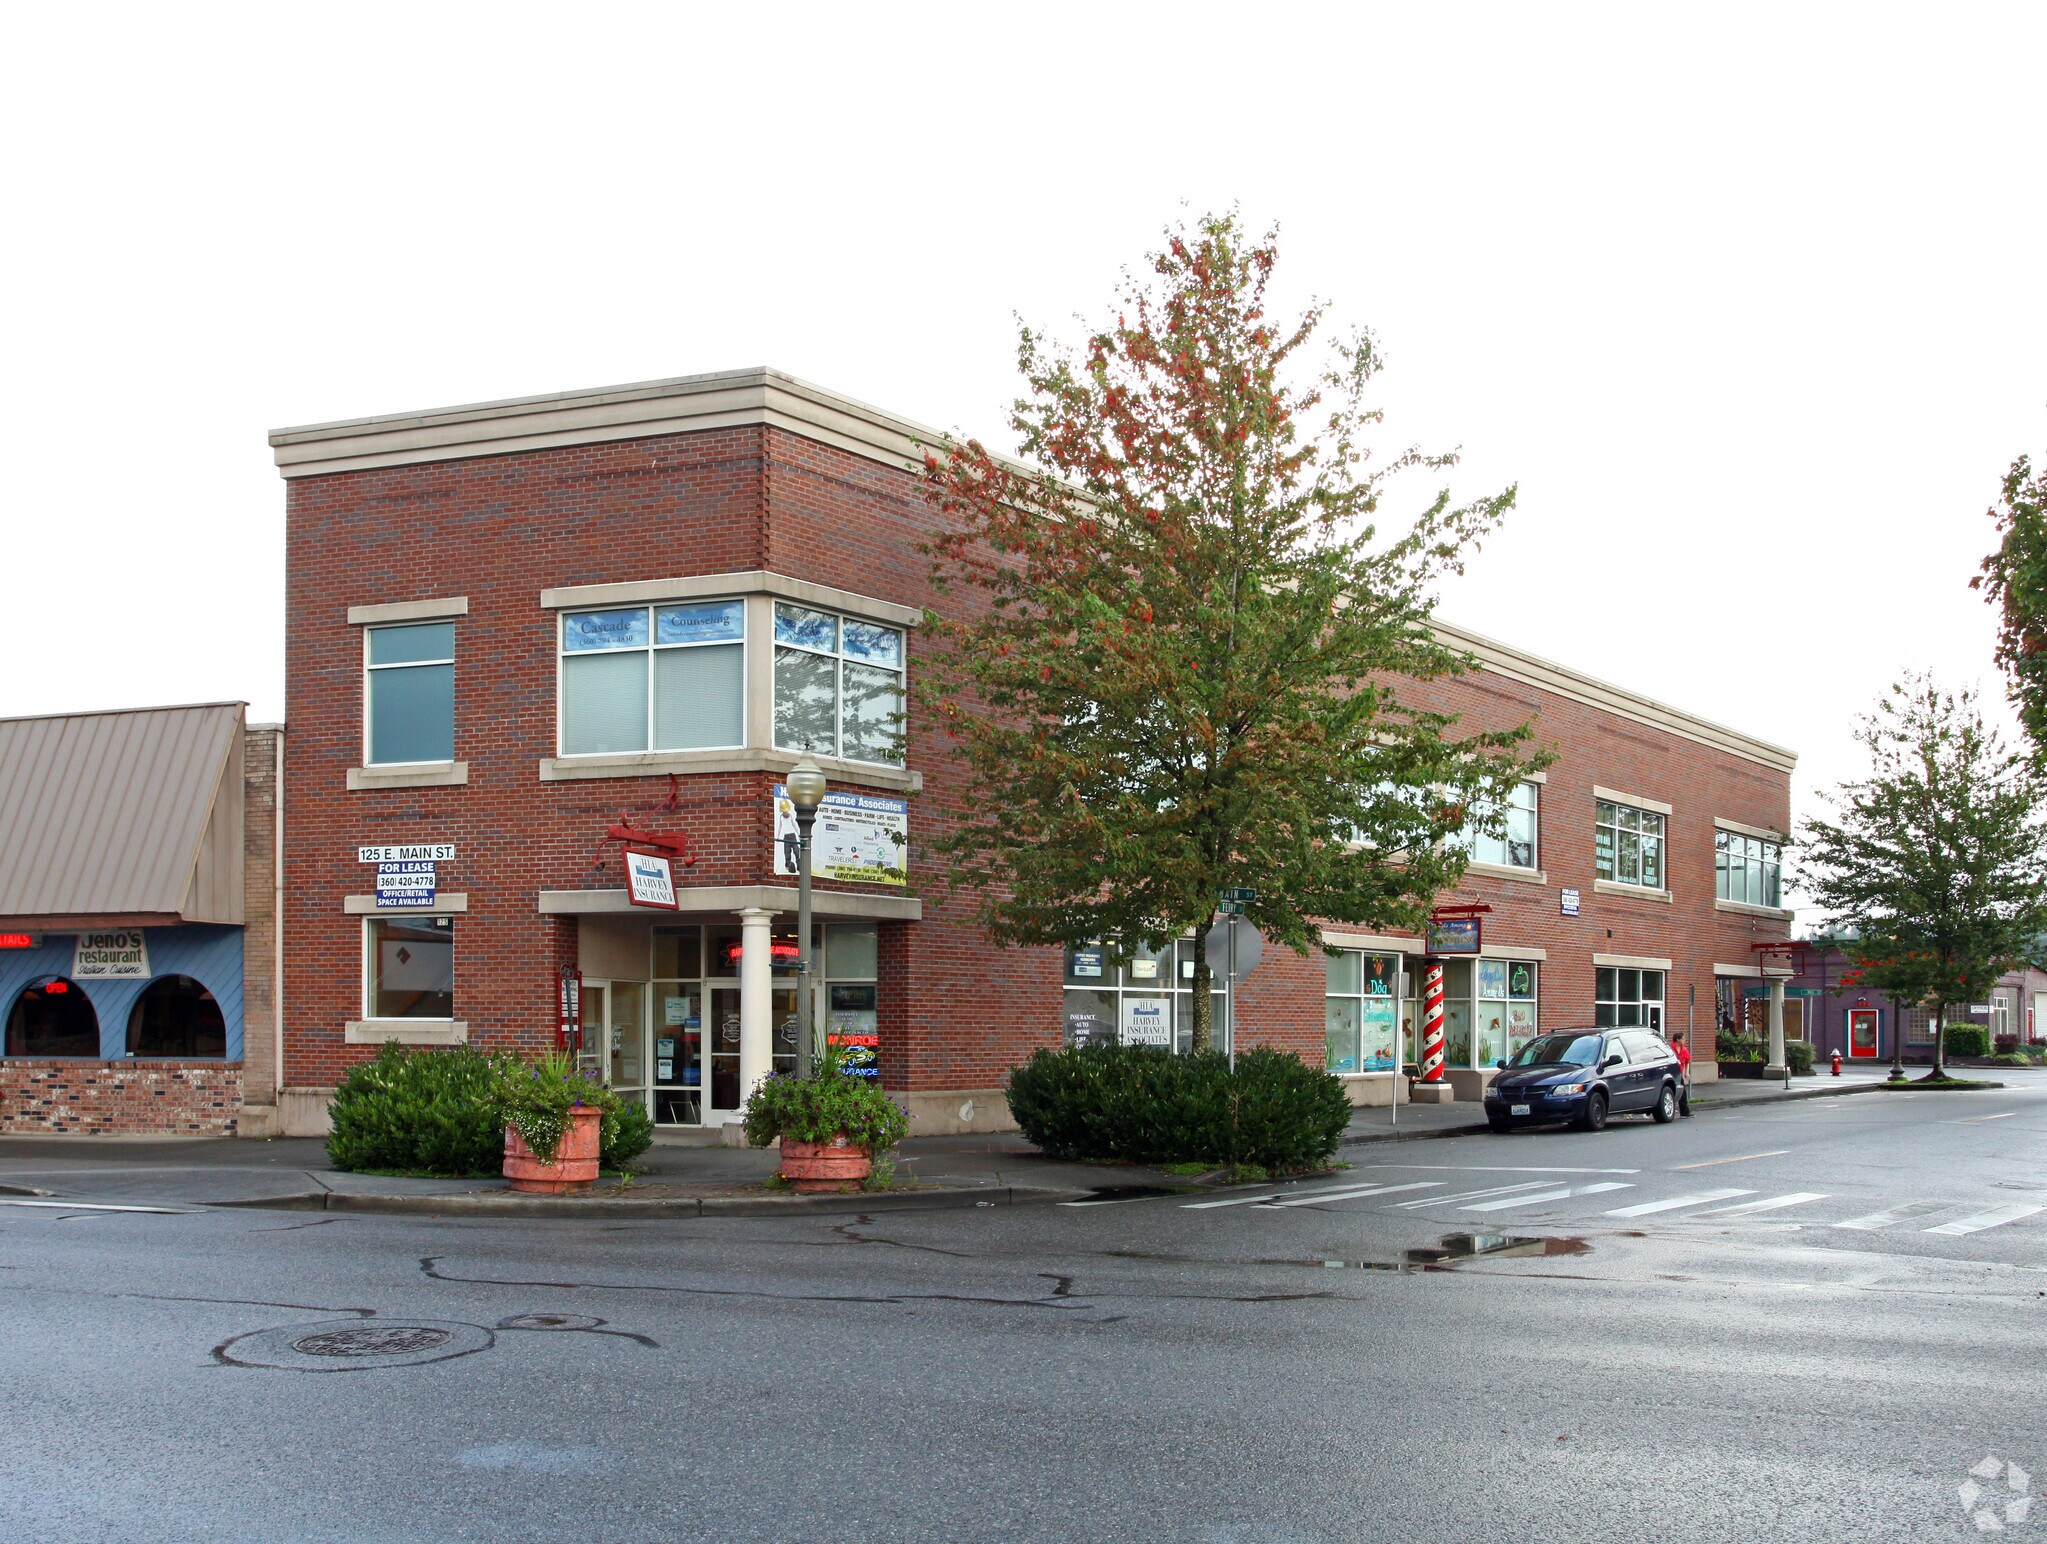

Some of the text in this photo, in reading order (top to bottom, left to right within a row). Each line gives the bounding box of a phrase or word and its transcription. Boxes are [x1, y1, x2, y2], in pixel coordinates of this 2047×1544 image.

[581, 615, 730, 634] Cascade Counseling
[822, 794, 902, 812] surance Associates
[844, 810, 862, 818] BUSINESS
[361, 847, 453, 860] 125 E. MAIN ST.
[828, 855, 855, 863] TRAVELERS
[379, 862, 434, 872] FOR LEASE
[641, 858, 657, 870] HIA
[379, 877, 434, 887] (360) 420-4778
[636, 876, 668, 890] HARVEY
[378, 897, 433, 906] SPACE AVAILABLE
[1222, 903, 1236, 912] FERRY
[0, 935, 29, 945] TAILS
[82, 931, 141, 949] Jeno's
[79, 950, 142, 963] restaurant
[78, 964, 141, 975] Italian Cuisine
[46, 982, 67, 993] OPEN
[1370, 979, 1387, 996] Dog
[1140, 1001, 1153, 1010] HIA
[1133, 1017, 1161, 1025] HARVEY
[1127, 1026, 1166, 1034] INSURANCE
[828, 1034, 879, 1046] MONROE
